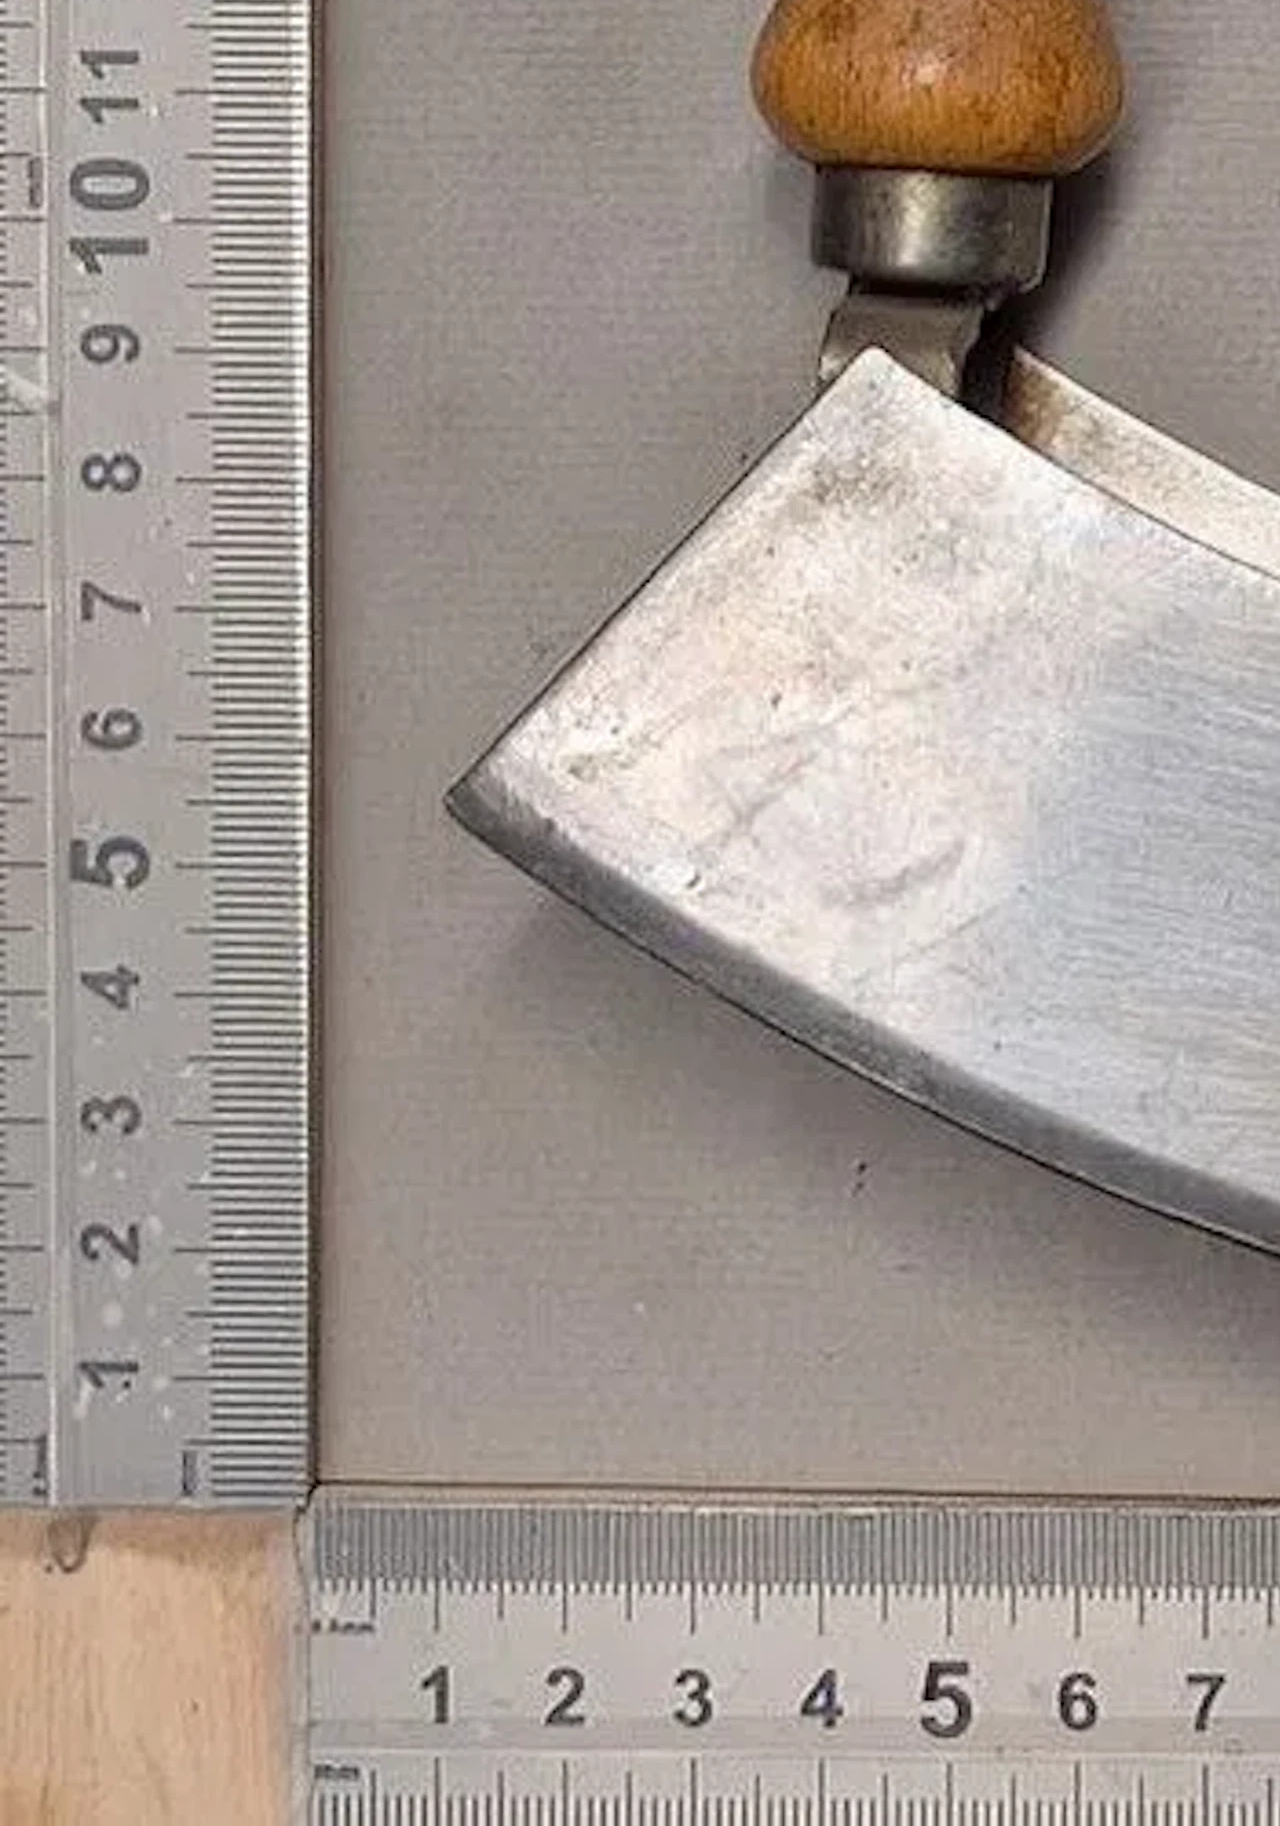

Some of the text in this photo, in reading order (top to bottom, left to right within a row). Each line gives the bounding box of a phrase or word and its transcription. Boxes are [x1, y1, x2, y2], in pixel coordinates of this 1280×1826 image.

[78, 49, 141, 125] 11
[67, 158, 150, 275] 10
[80, 324, 141, 365] 9
[80, 453, 142, 493] 8
[80, 581, 142, 622] 7
[80, 709, 142, 751] 6
[68, 836, 151, 891] 5
[79, 964, 141, 1011] 4
[80, 1095, 142, 1136] 3
[79, 1223, 140, 1266] 2
[77, 1360, 140, 1389] 1
[421, 1665, 449, 1725] 1
[545, 1667, 585, 1727] 2
[673, 1669, 713, 1728] 3
[800, 1669, 844, 1729] 4
[920, 1661, 972, 1739] 5
[1058, 1673, 1098, 1732] 6
[1186, 1674, 1226, 1732] 7
